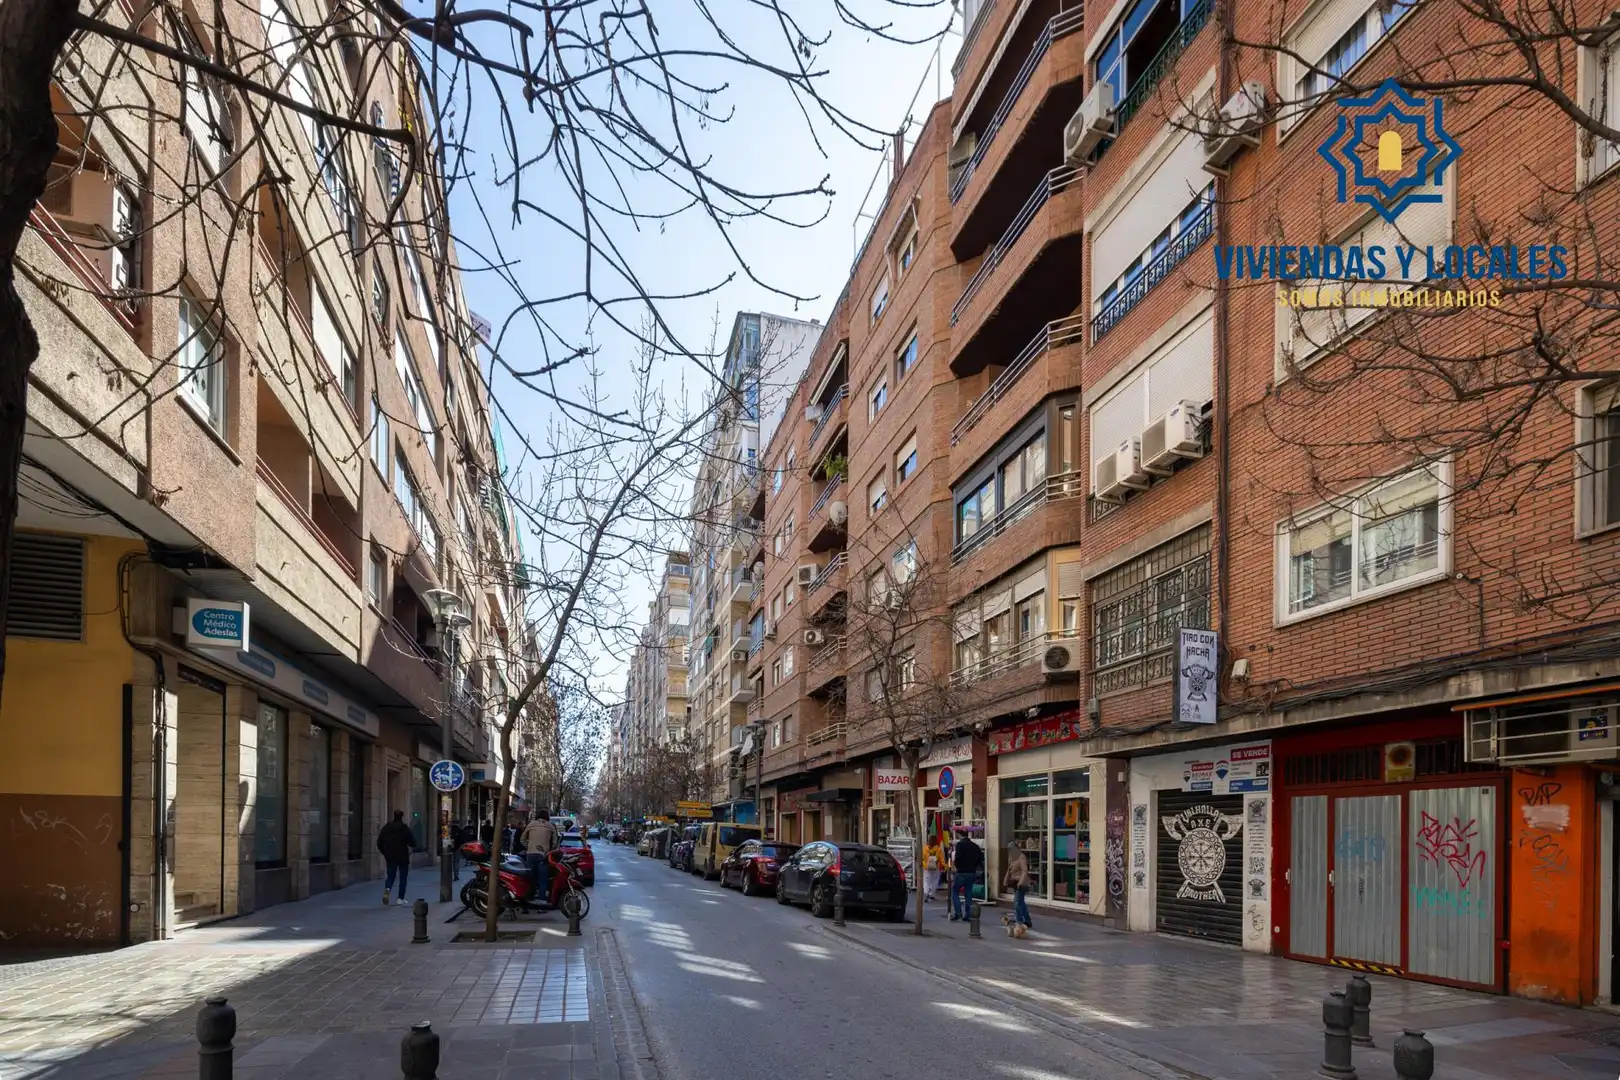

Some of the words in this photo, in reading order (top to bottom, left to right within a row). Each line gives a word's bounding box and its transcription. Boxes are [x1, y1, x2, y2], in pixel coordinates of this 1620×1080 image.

[204, 611, 235, 620] Centro
[204, 619, 237, 629] Médico
[204, 627, 238, 637] Adeslas
[1186, 646, 1210, 661] HACHA
[1232, 751, 1242, 759] SE
[1244, 747, 1268, 757] VENDE
[878, 775, 910, 785] BAZAR
[1181, 805, 1220, 823] VALHALLA
[1191, 818, 1212, 828] AXE
[1182, 887, 1221, 903] BROTHER
